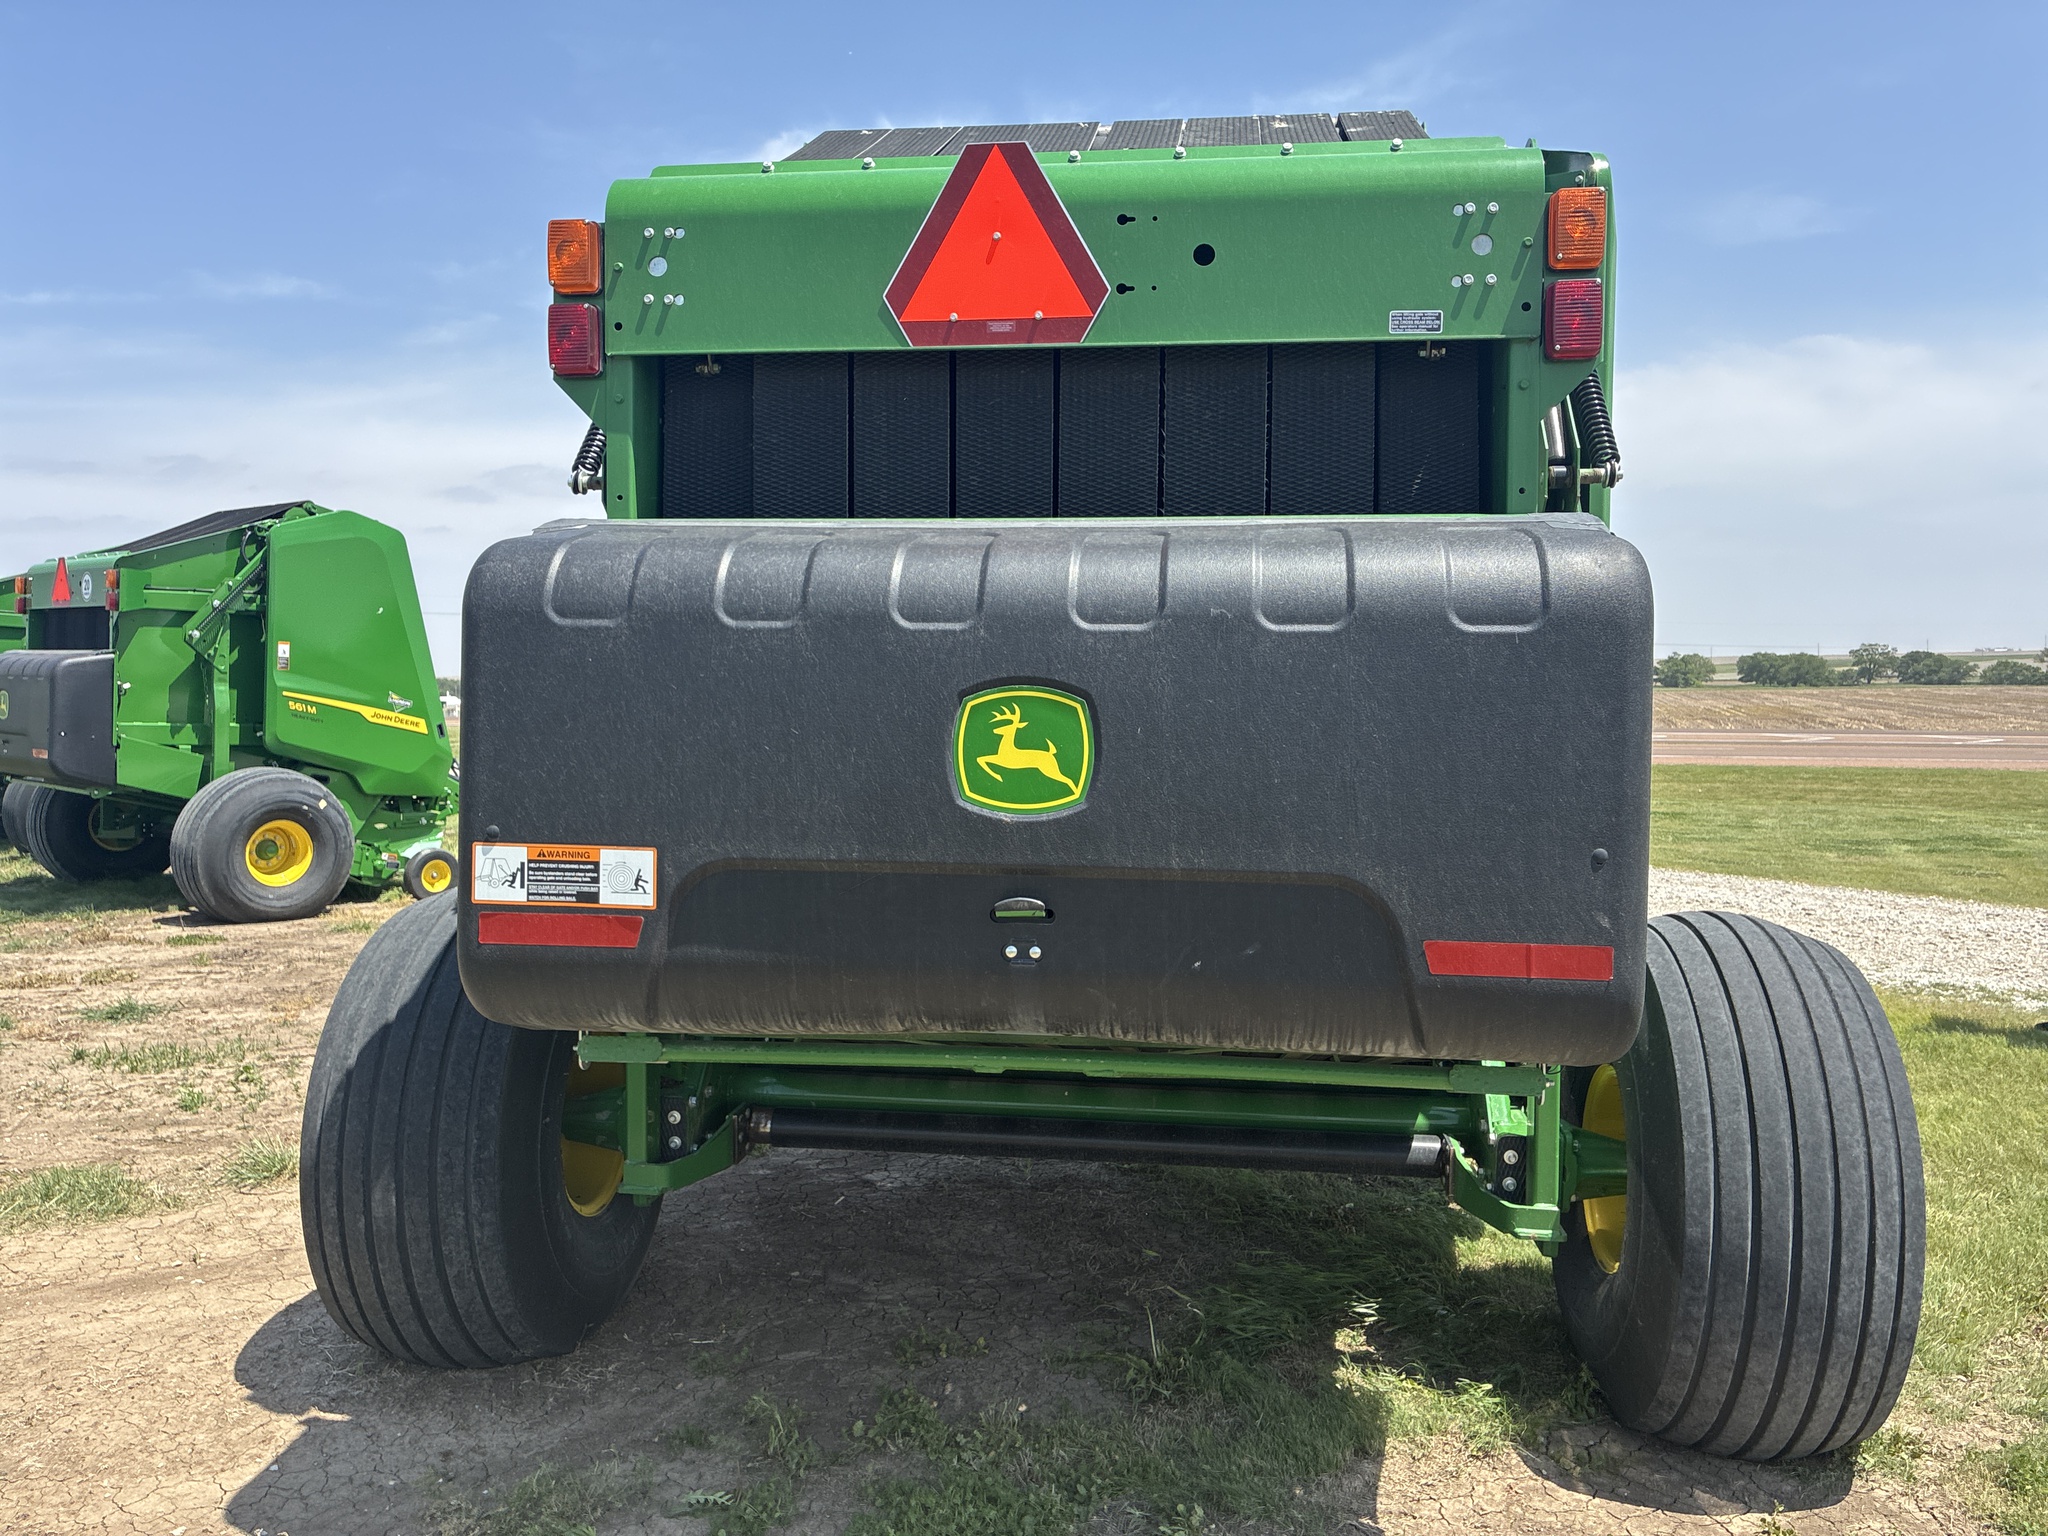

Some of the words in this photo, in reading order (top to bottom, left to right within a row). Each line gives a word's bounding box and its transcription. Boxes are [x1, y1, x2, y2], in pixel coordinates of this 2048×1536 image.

[84, 579, 90, 591] 20
[371, 711, 393, 722] JOHN
[394, 715, 420, 728] DEERE
[547, 850, 590, 859] WARNING
